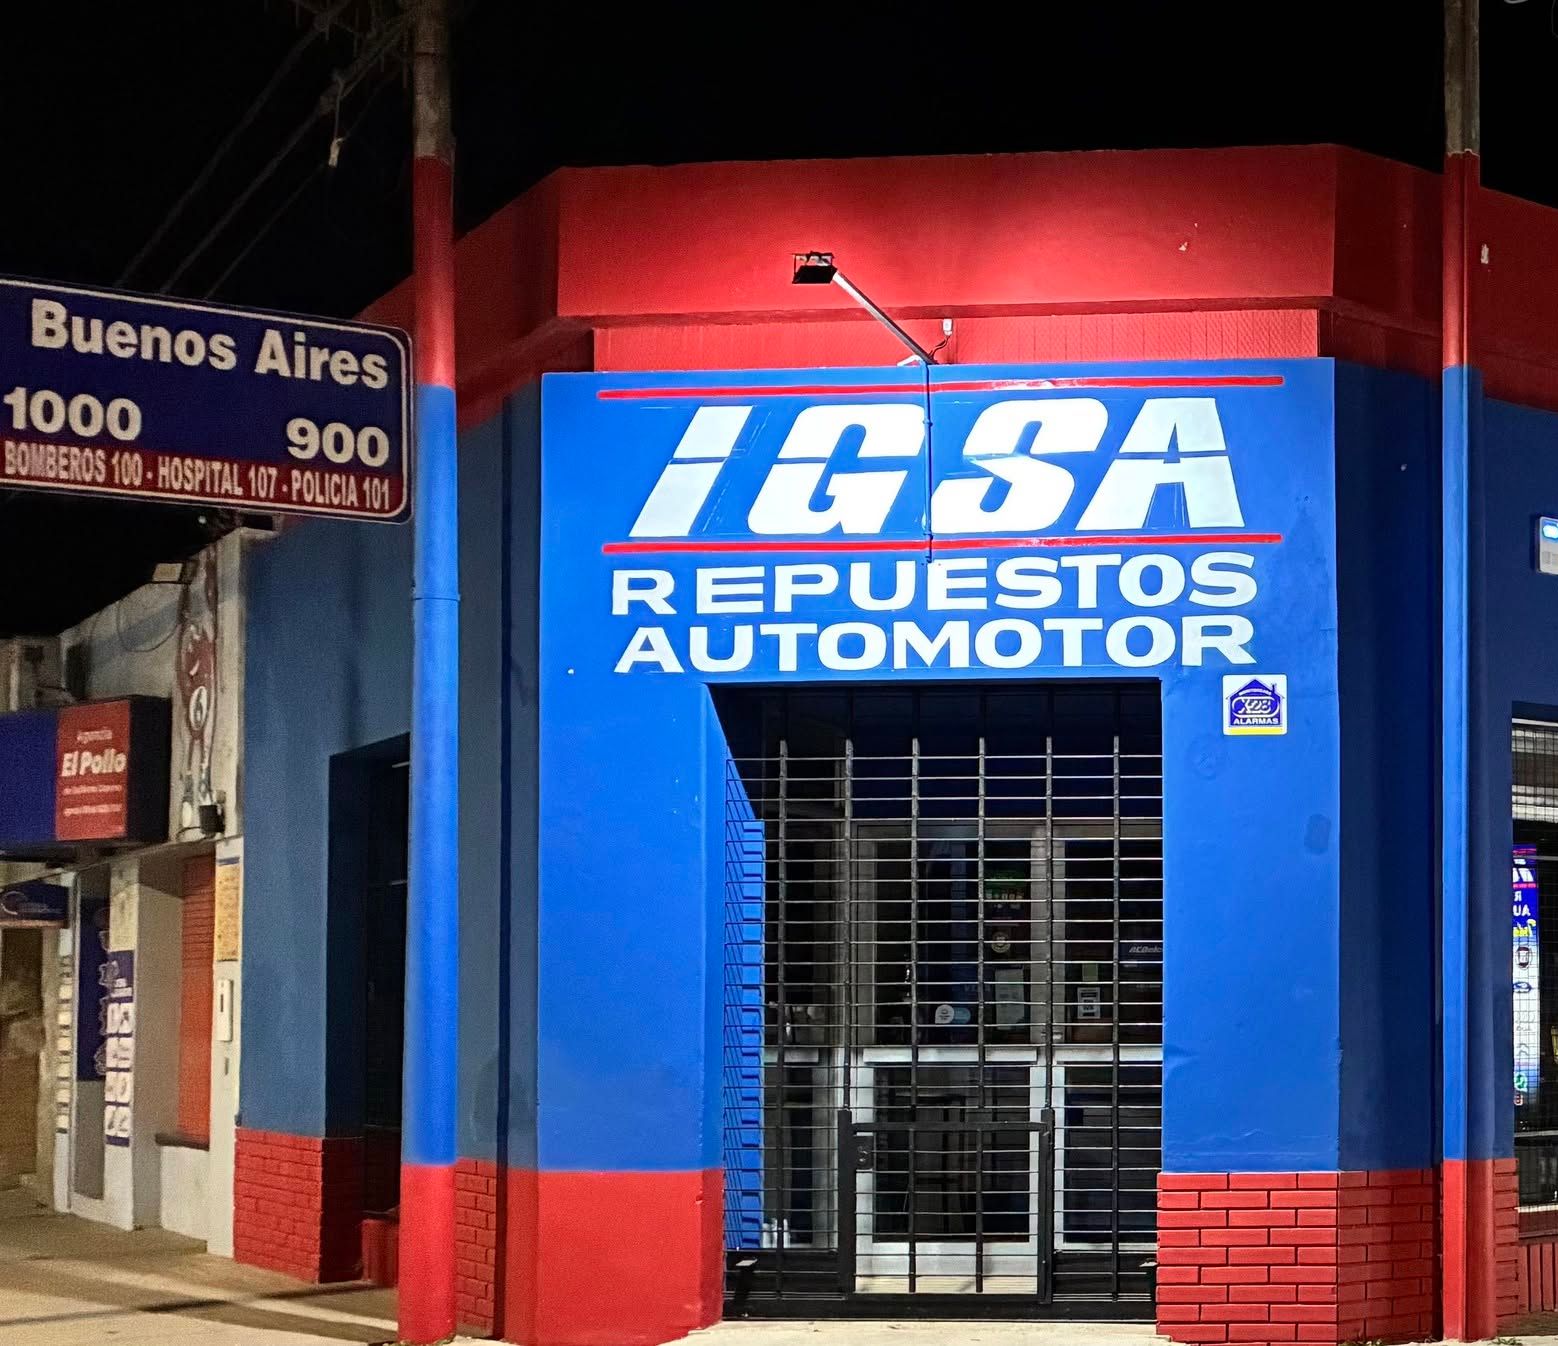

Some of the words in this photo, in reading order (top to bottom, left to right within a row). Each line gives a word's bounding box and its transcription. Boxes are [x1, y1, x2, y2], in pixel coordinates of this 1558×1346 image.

[32, 299, 237, 371] Buenos
[254, 328, 389, 390] Aires
[4, 387, 143, 441] 1000
[286, 418, 390, 467] 900
[5, 440, 106, 483] BOMBEROS
[112, 450, 144, 486] 100
[158, 456, 243, 497] HOSPITAL
[249, 465, 277, 499] 107
[291, 468, 359, 507] POLICIA
[363, 476, 391, 510] 101
[628, 397, 1246, 537] IGSA
[612, 552, 1259, 616] REPUESTOS
[614, 614, 1258, 675] AUTOMOTOR
[1233, 717, 1279, 725] ALARMAS
[61, 750, 79, 777] El
[79, 747, 127, 776] Pollo
